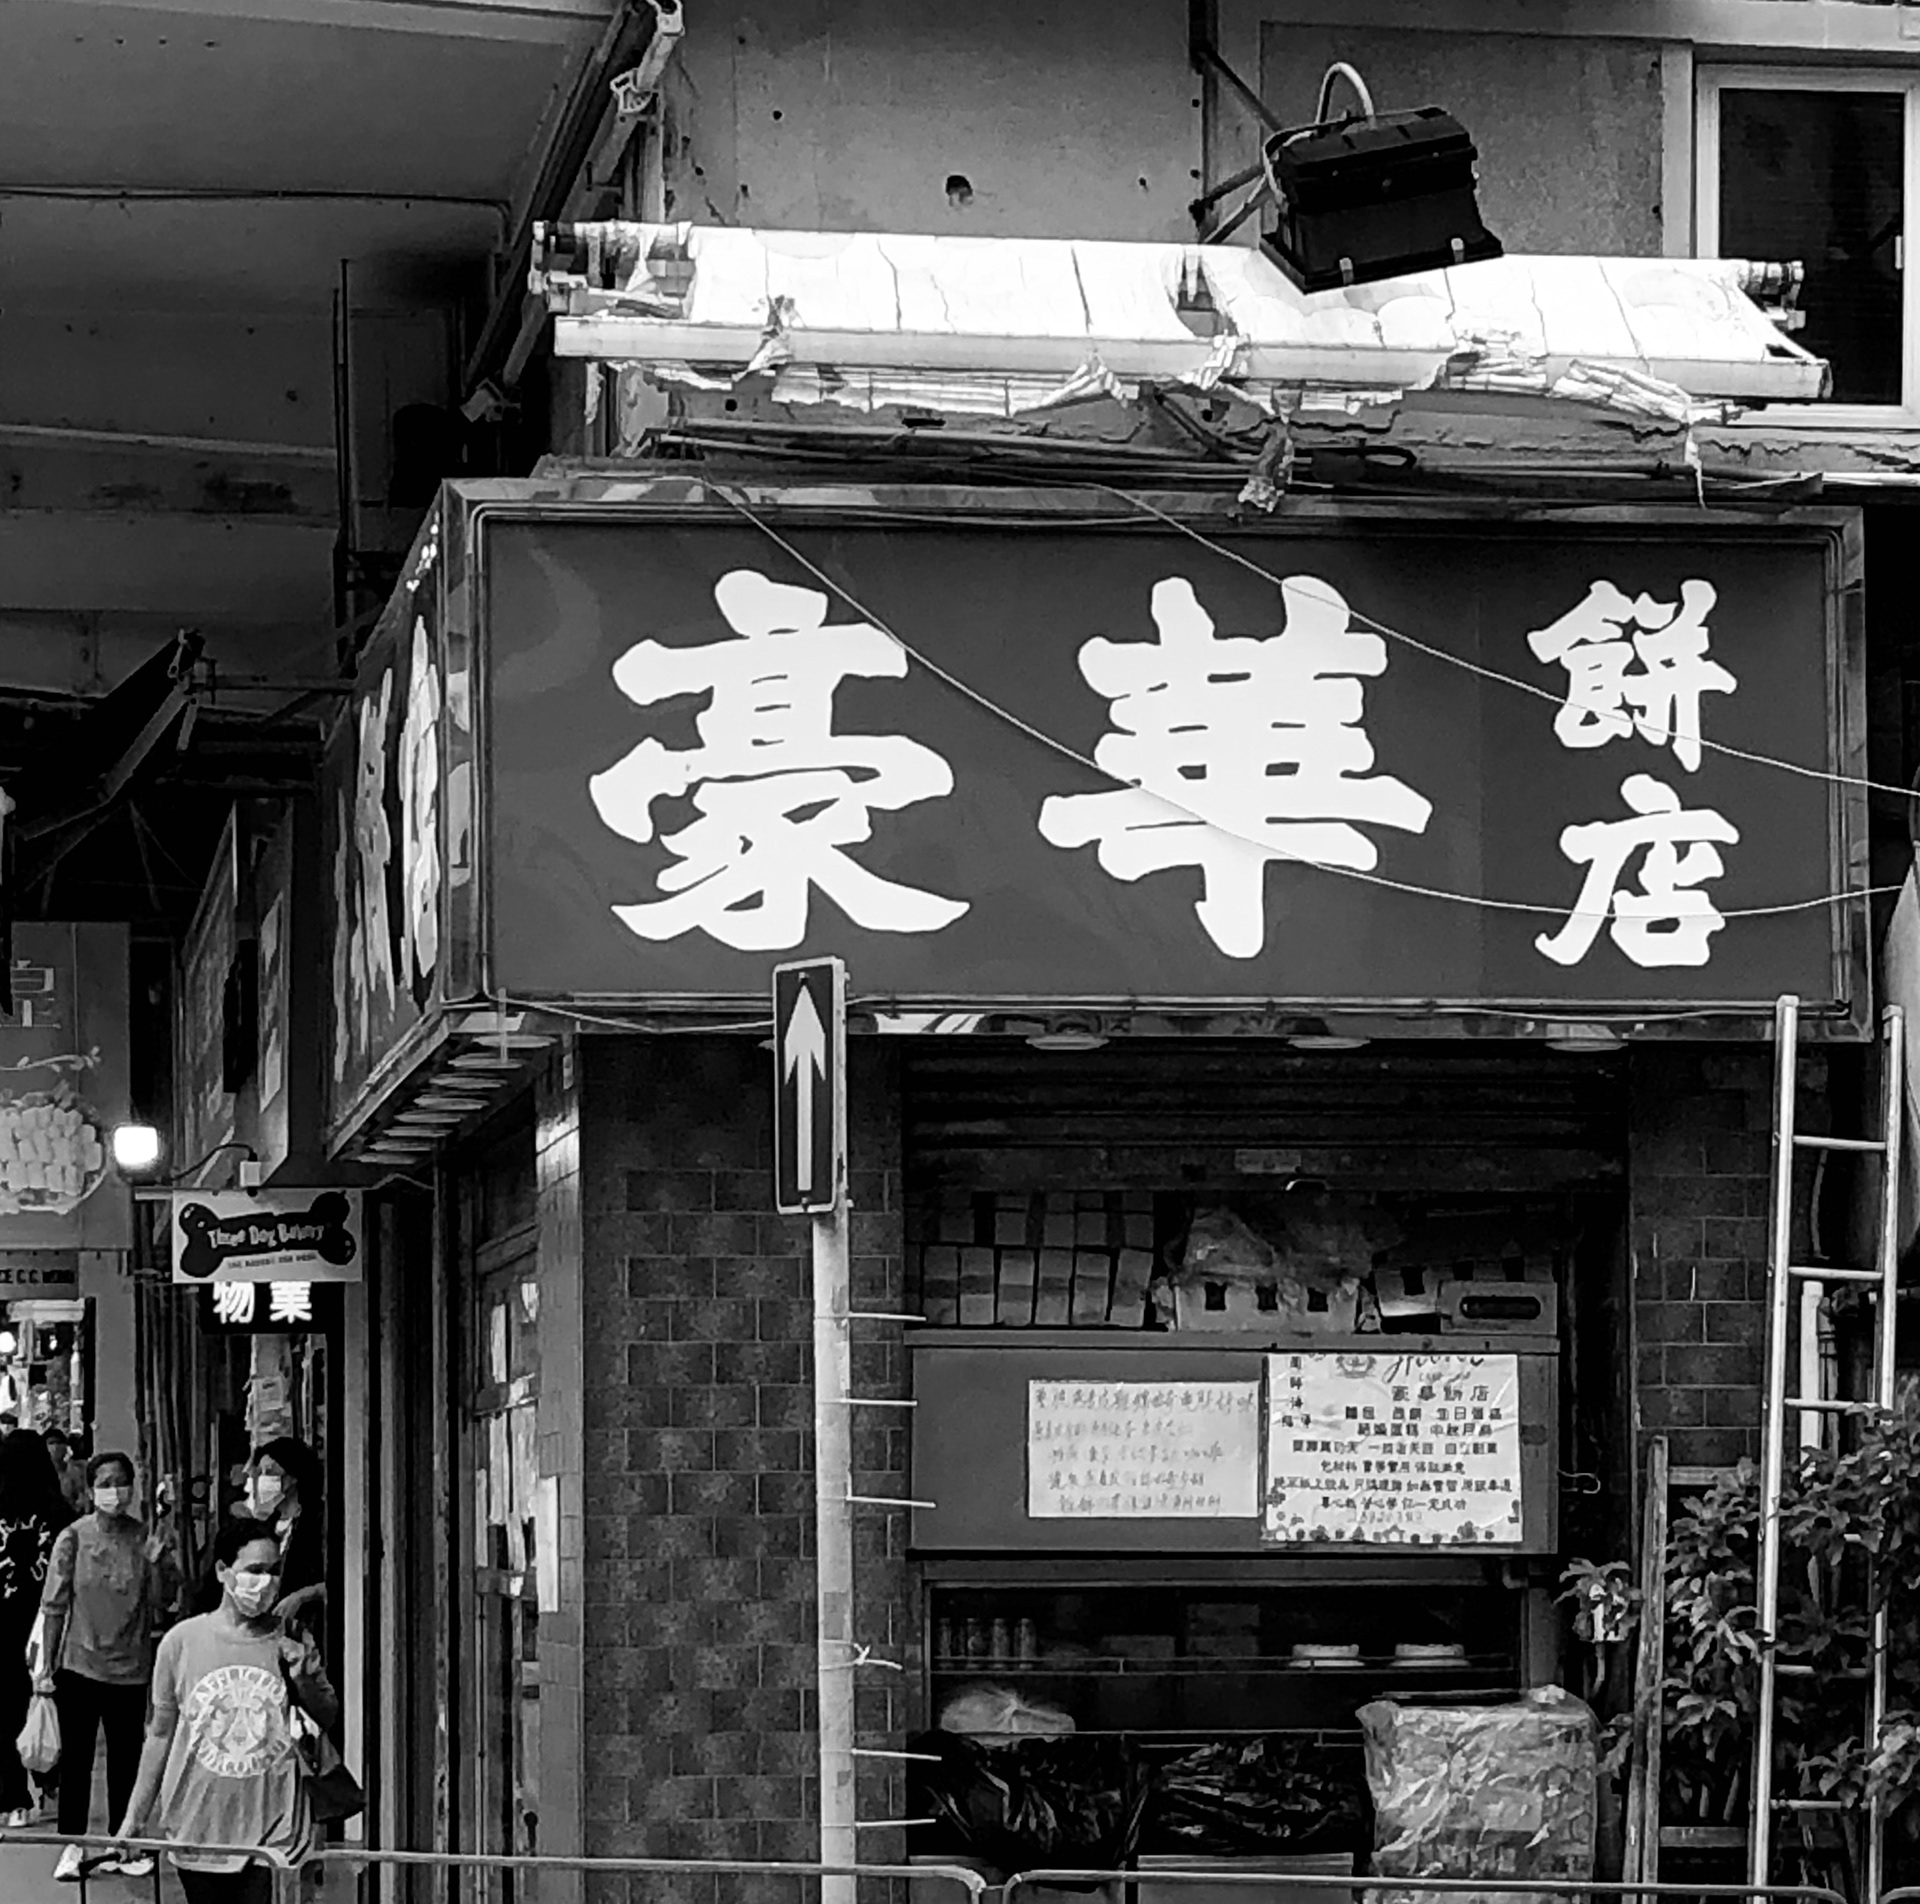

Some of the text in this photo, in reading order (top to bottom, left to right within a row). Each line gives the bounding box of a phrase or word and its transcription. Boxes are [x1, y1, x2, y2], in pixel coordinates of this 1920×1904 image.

[590, 571, 1432, 957] 豪華
[1528, 581, 1739, 966] 餅店
[213, 1281, 313, 1324] 物業
[248, 1225, 278, 1248] Dog
